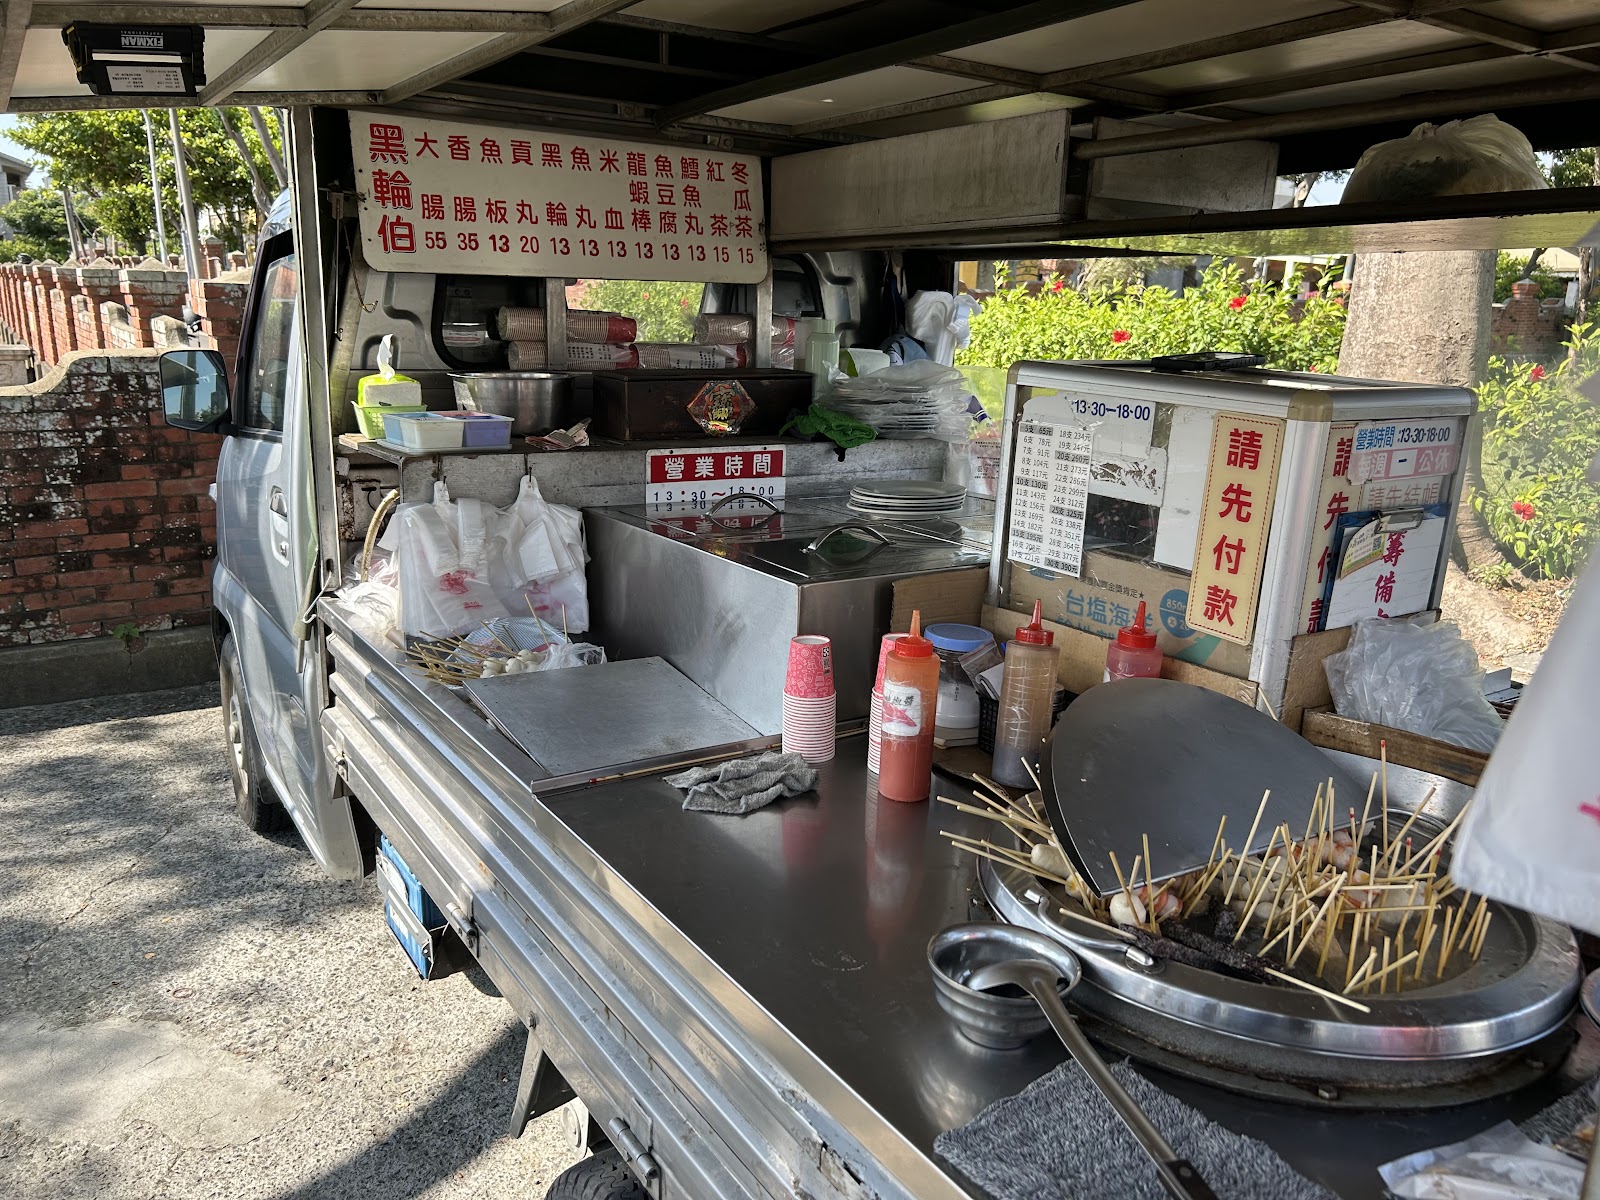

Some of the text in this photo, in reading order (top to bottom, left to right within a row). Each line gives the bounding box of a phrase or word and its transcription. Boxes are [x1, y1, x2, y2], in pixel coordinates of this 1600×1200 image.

[121, 36, 164, 47] FIXMAN
[369, 122, 417, 254] 黑輪伯
[414, 131, 445, 221] 大腸
[447, 135, 477, 223] 香腸
[479, 137, 509, 225] 魚板
[510, 139, 539, 225] 貢丸
[541, 142, 568, 227] 黑輪
[570, 145, 597, 230] 魚丸
[599, 148, 625, 231] 米血
[626, 151, 652, 233] 龍蝦棒
[653, 154, 678, 235] 魚豆腐
[706, 158, 729, 238] 紅茶
[731, 161, 753, 239] 冬瓜茶
[425, 231, 754, 264] 55 35 13 20 13 13 13 13 13 13 15 15
[664, 453, 772, 480] 營業時間
[1355, 425, 1396, 451] 營業時間
[1203, 428, 1263, 627] 請先付款
